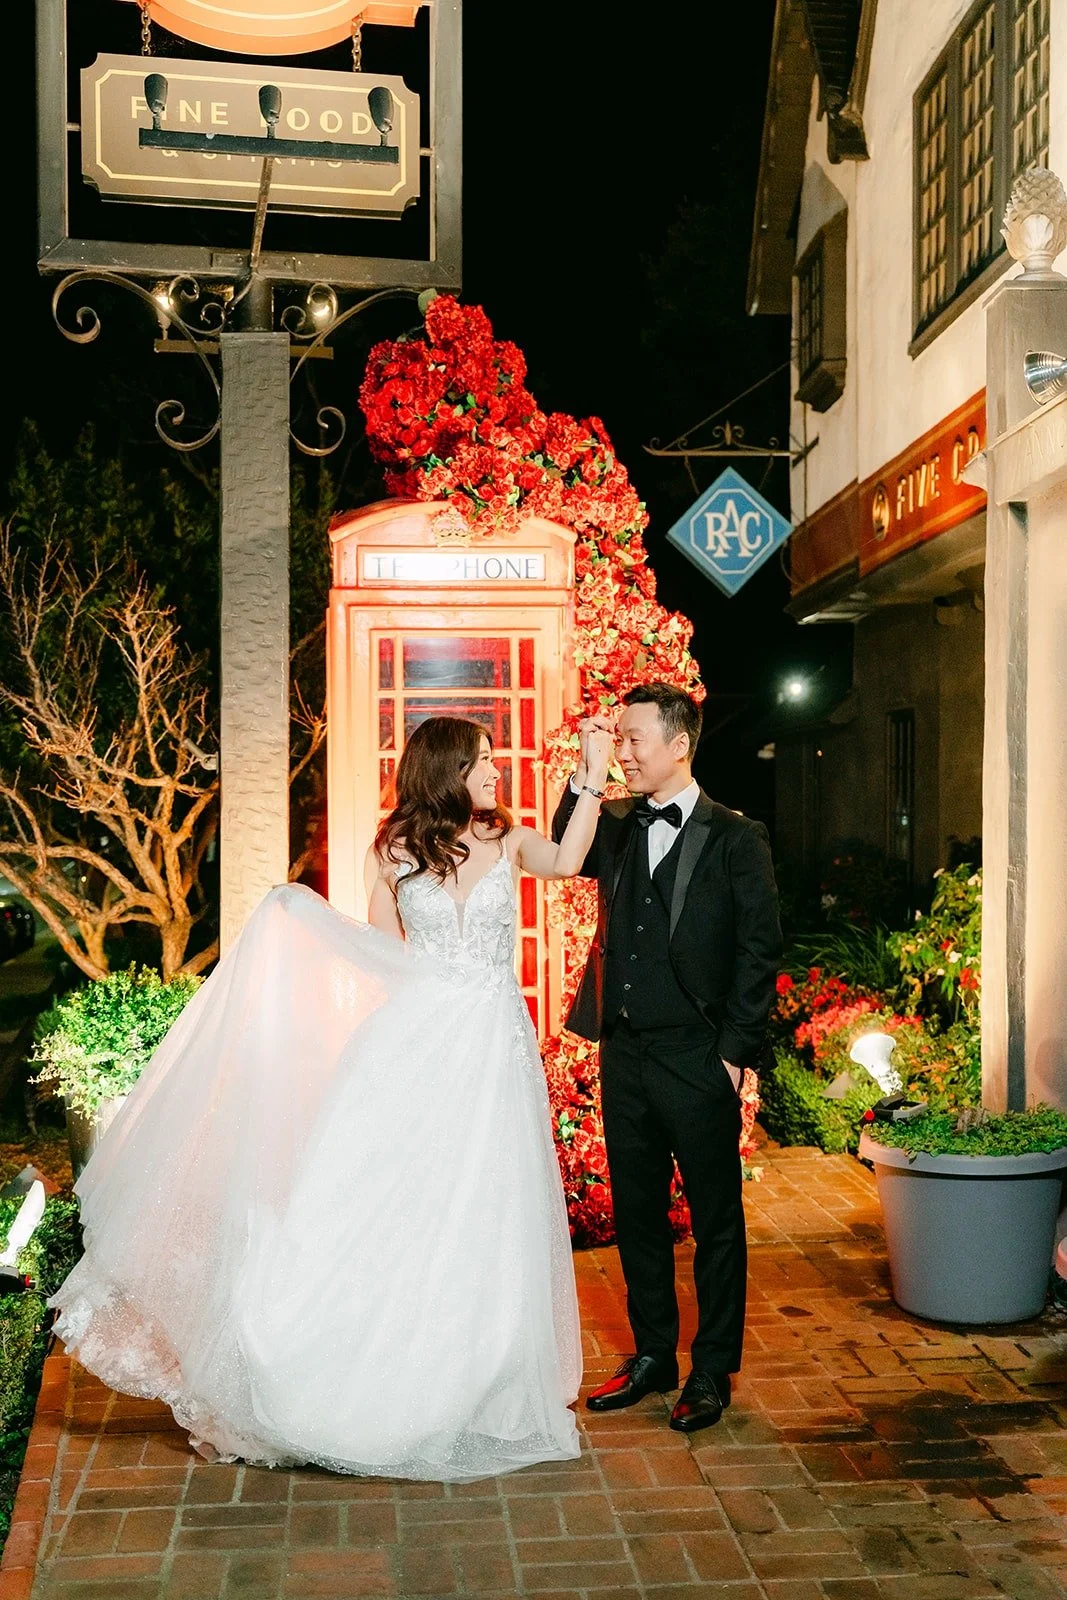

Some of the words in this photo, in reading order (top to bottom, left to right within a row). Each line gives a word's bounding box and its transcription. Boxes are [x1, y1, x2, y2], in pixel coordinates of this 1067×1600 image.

[260, 106, 373, 135] OOD
[897, 456, 940, 520] FIVE
[704, 499, 762, 557] RAC
[372, 557, 538, 579] TEHONE
